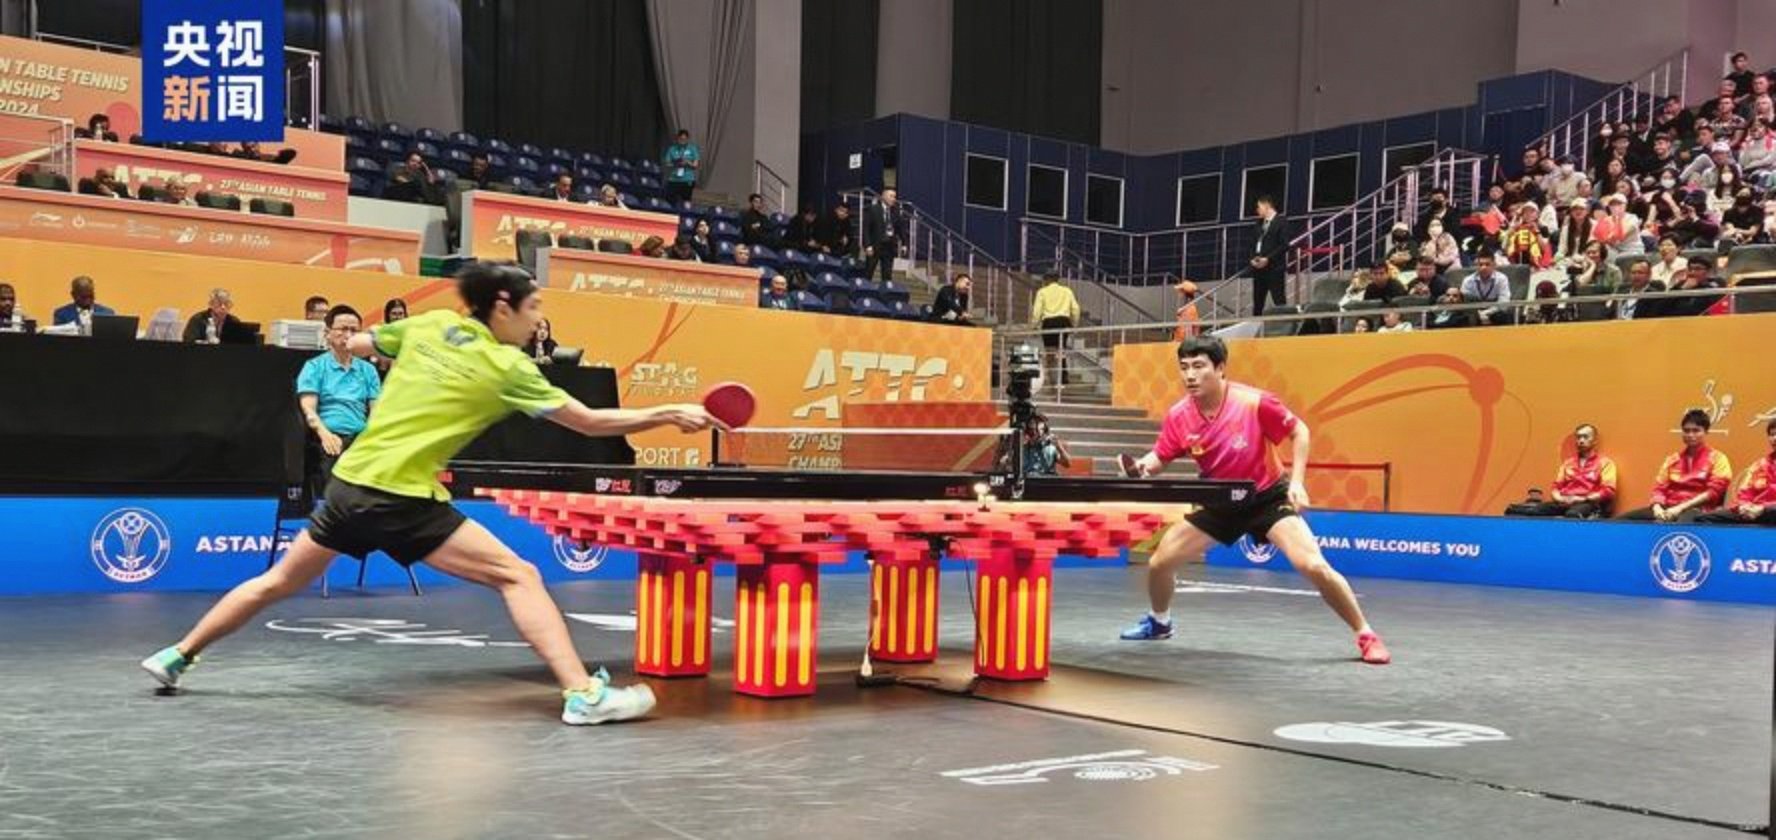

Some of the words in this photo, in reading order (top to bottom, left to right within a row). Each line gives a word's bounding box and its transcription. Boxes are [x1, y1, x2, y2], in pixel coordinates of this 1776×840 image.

[15, 60, 69, 82] TABLE
[71, 68, 129, 92] TENNIS
[636, 447, 680, 465] PORT
[1354, 538, 1441, 555] WELCOMES
[1446, 543, 1480, 557] YOU
